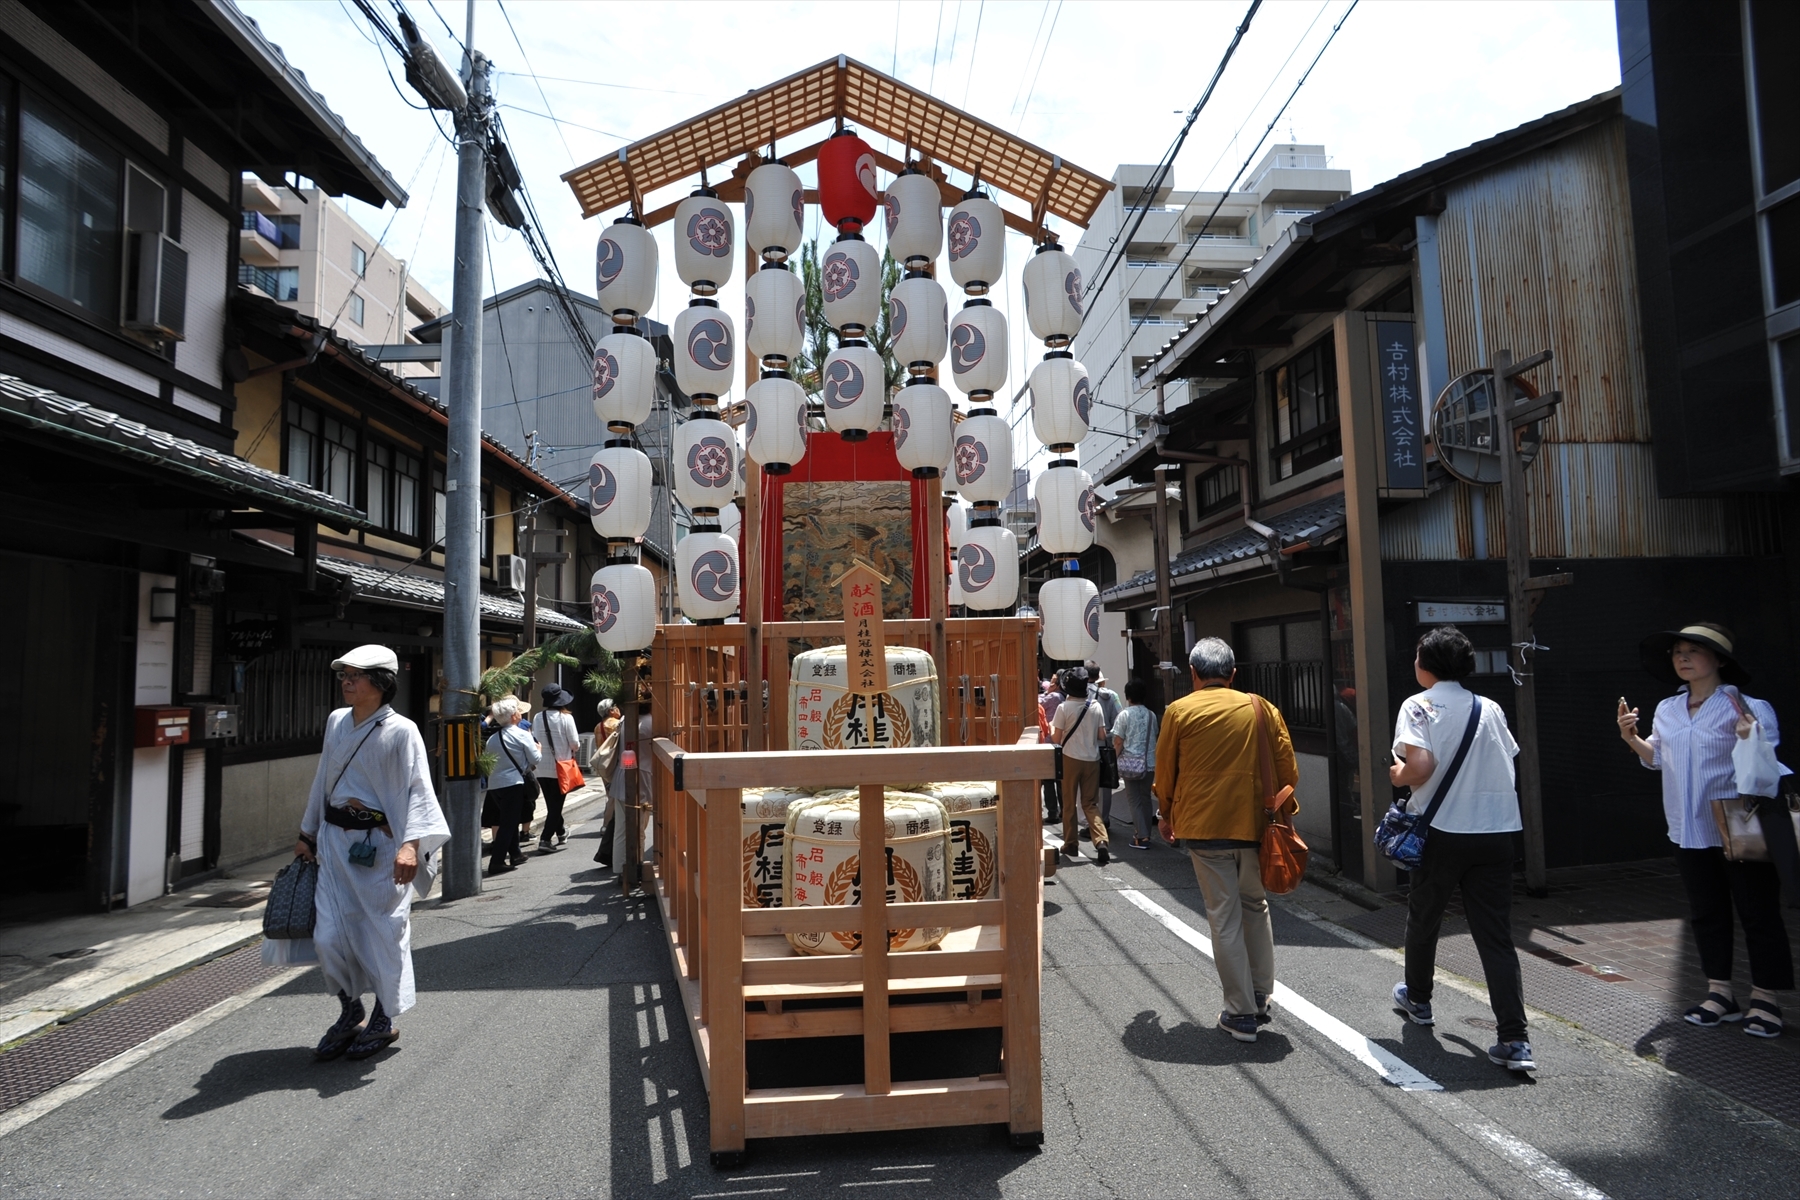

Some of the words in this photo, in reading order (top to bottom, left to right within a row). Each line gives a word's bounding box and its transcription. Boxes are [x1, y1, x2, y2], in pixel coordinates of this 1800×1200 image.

[850, 583, 875, 617] 献酒
[857, 618, 875, 688] 月桂冠株式会社
